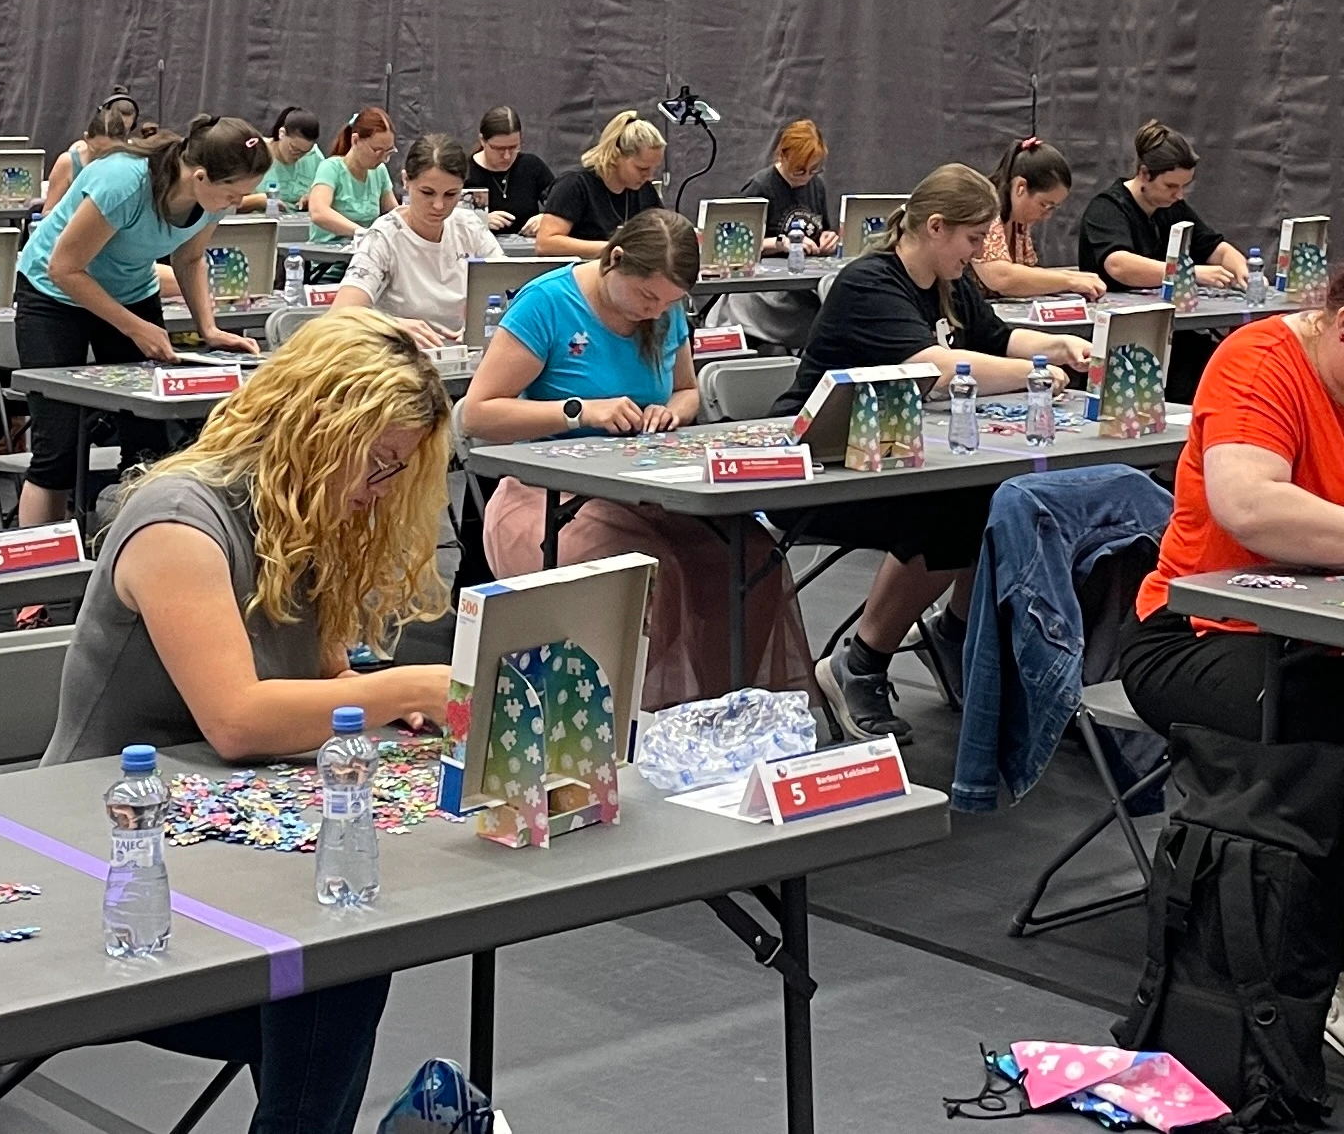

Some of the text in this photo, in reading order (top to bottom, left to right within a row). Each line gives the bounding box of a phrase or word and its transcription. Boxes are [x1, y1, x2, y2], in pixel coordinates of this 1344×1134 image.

[167, 379, 185, 391] 24
[719, 461, 739, 475] 14
[460, 597, 479, 617] 500
[790, 781, 807, 806] 5
[115, 839, 146, 852] RAJEC
